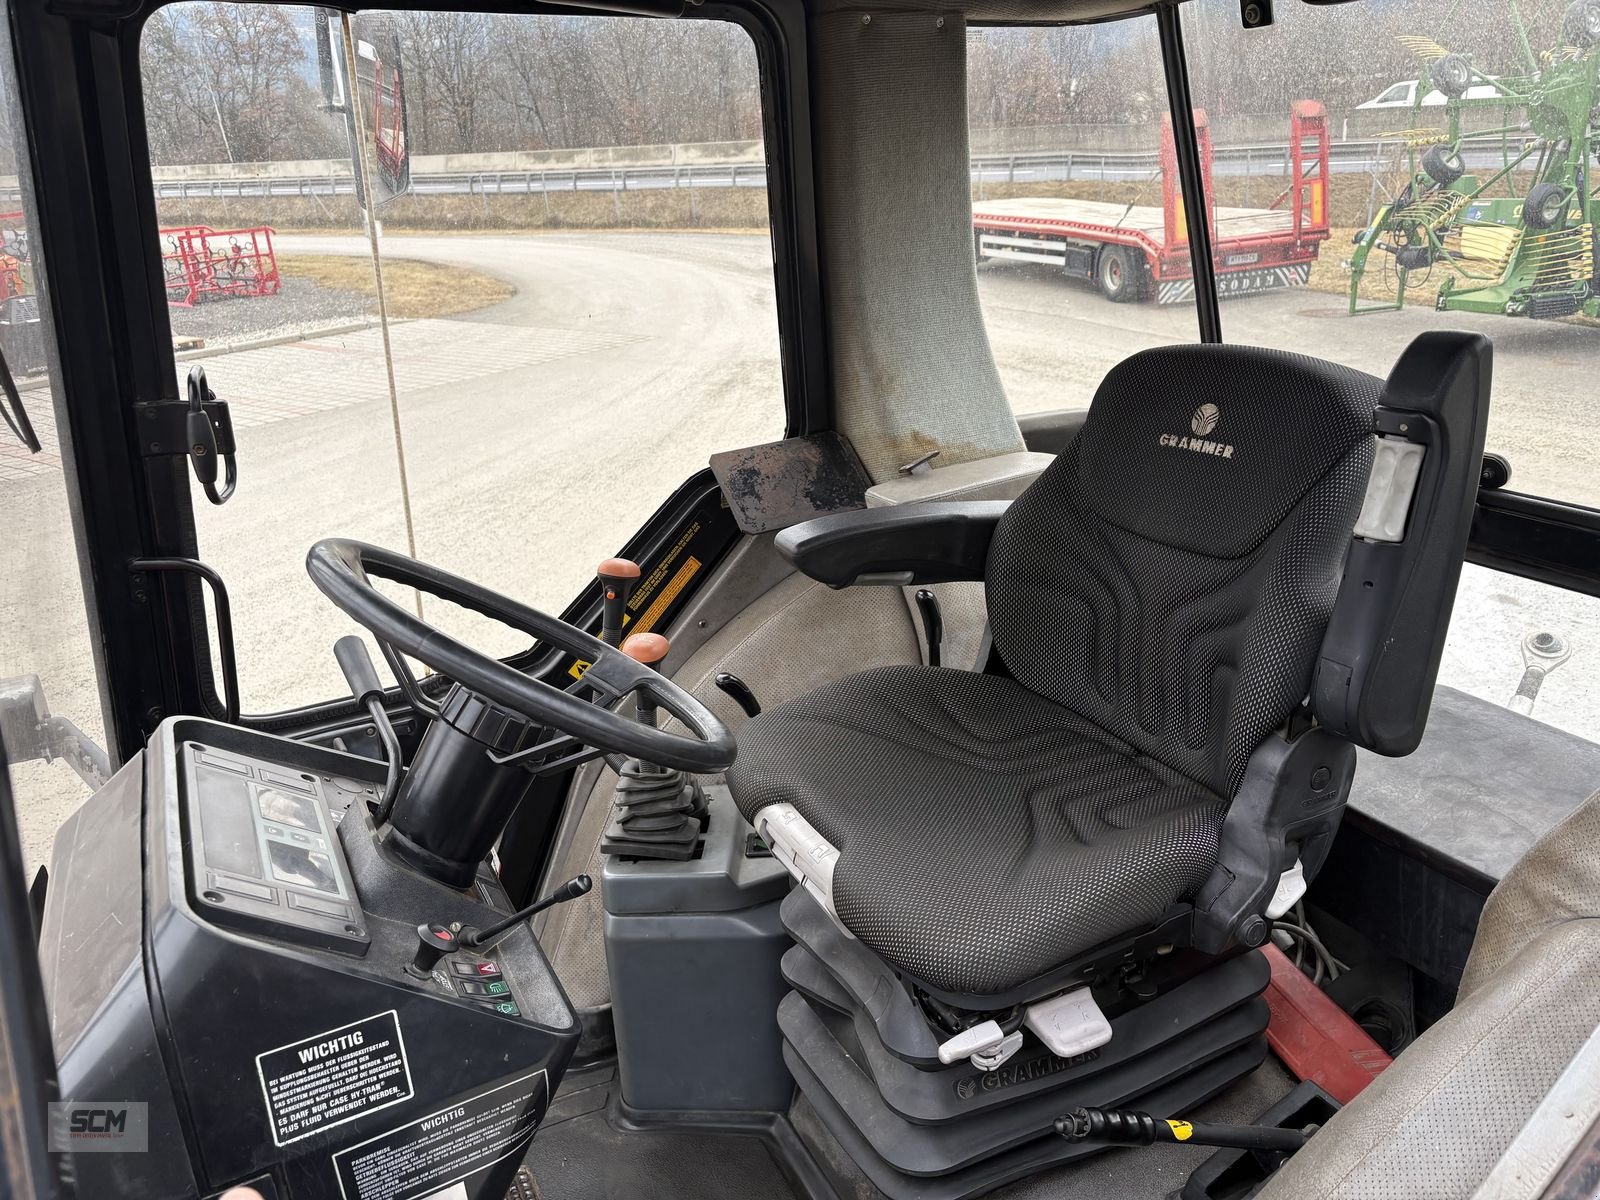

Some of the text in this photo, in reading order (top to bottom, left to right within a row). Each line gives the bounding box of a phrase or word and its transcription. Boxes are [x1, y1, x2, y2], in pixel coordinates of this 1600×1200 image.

[1160, 433, 1234, 460] GRAMMER
[298, 1031, 363, 1064] WICHTIG
[278, 1117, 288, 1126] ES
[290, 1109, 309, 1122] DARF
[312, 1103, 327, 1114] NUR
[329, 1095, 348, 1107] CASE
[286, 1092, 308, 1104] SYSTEM
[280, 1123, 299, 1135] PLUS
[301, 1114, 322, 1127] FLUID
[324, 1097, 366, 1118] VERWENDET
[421, 1107, 465, 1132] WICHTIG
